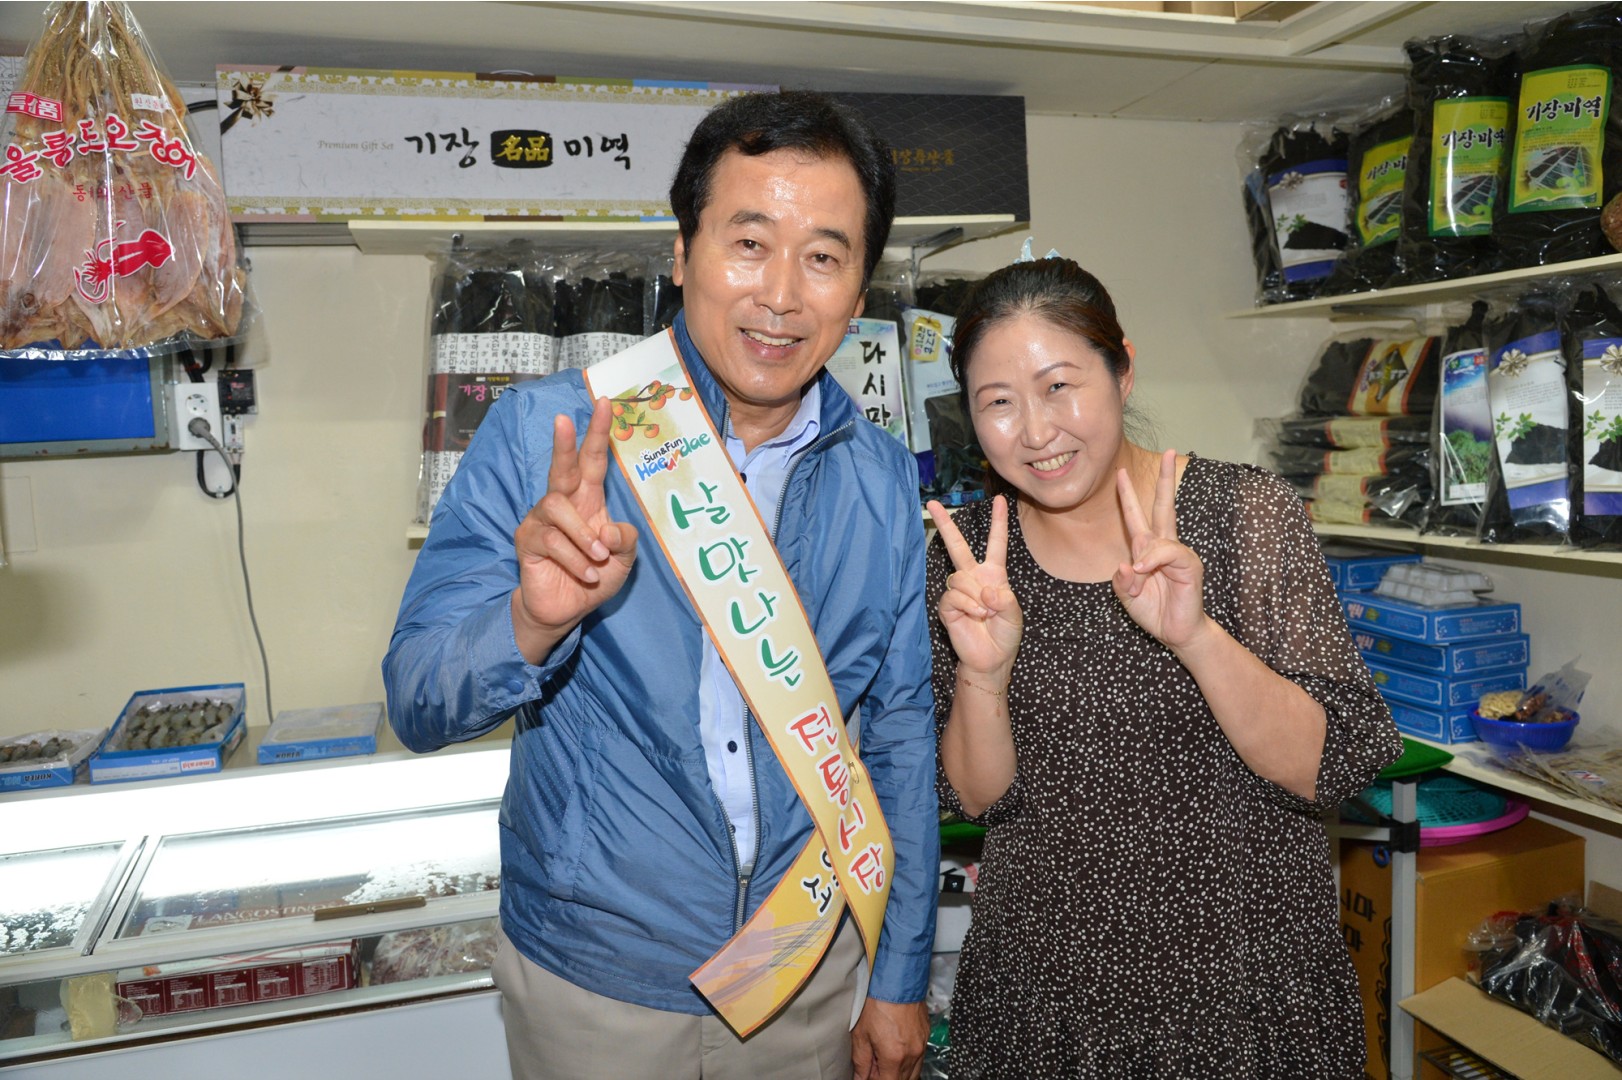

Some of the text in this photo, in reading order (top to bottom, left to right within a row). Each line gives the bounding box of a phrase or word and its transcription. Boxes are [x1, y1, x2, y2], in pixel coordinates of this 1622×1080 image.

[317, 139, 394, 152] Premium Gift Set
[404, 127, 631, 170] 기장 名品 미역
[458, 383, 487, 402] 기장
[859, 340, 892, 428] 다시마
[635, 430, 712, 483] Haeundae
[643, 437, 684, 466] Sun&Fun
[671, 481, 801, 688] 살맛나는
[182, 759, 215, 770] Emerald
[790, 706, 887, 892] 전통시장
